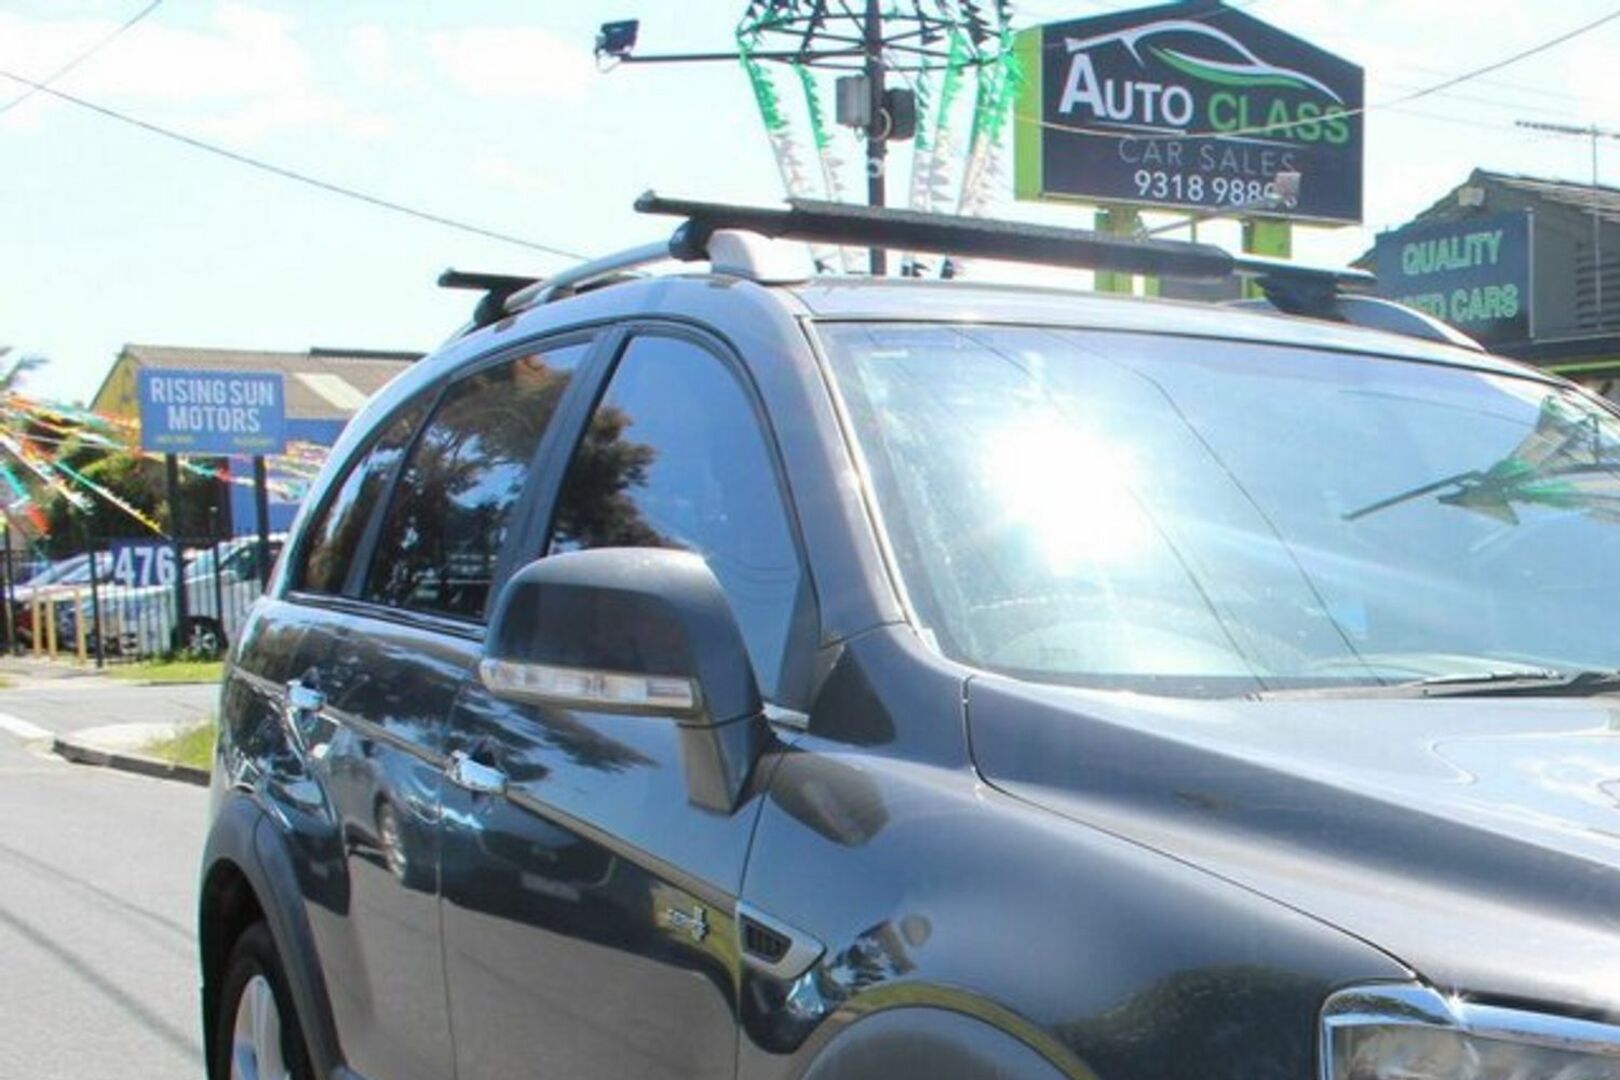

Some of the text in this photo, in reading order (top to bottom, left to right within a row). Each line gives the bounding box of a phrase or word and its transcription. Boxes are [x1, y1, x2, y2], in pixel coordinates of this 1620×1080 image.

[1059, 53, 1349, 144] AUTO CLASS
[1118, 138, 1296, 174] CAR SALES
[1134, 169, 1204, 201] 9318
[1402, 230, 1502, 276] QUALITY
[1450, 283, 1518, 322] CARS
[151, 377, 275, 406] RISING SUN
[168, 405, 261, 432] MOTORS
